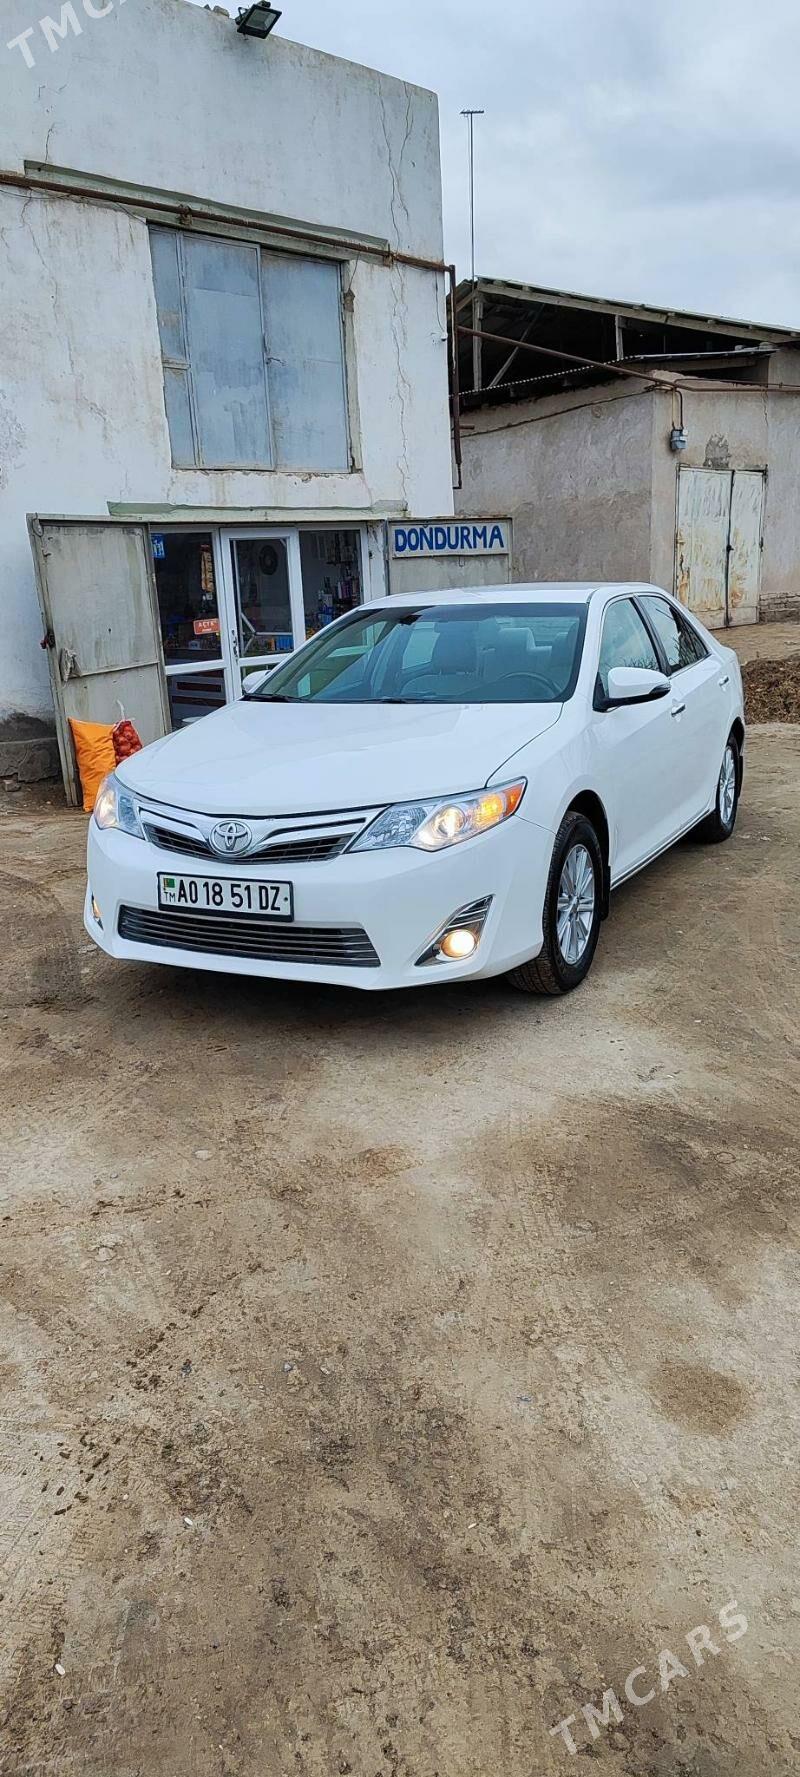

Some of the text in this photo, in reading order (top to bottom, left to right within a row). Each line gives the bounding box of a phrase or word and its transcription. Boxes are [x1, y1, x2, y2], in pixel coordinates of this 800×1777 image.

[164, 891, 175, 903] TM
[202, 881, 223, 906] 18
[230, 883, 252, 909] 51
[258, 885, 281, 911] DZ
